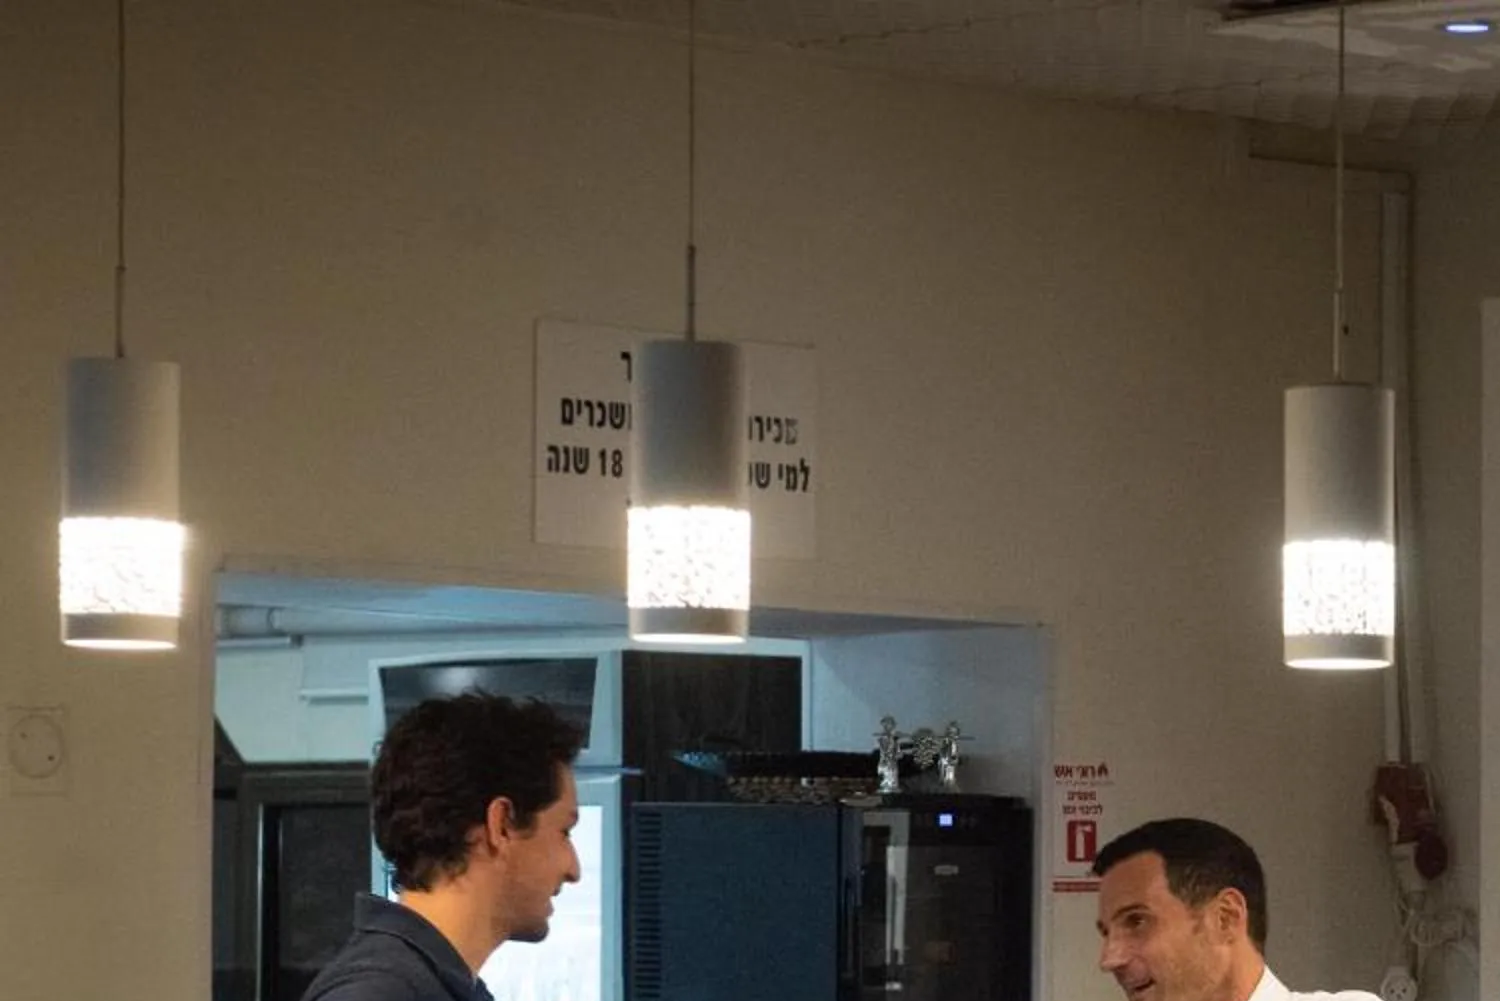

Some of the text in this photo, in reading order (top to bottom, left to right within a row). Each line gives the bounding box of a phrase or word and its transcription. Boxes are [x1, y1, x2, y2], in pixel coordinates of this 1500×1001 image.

[547, 444, 589, 475] שנה
[599, 447, 623, 478] 18
[778, 457, 810, 492] למי
